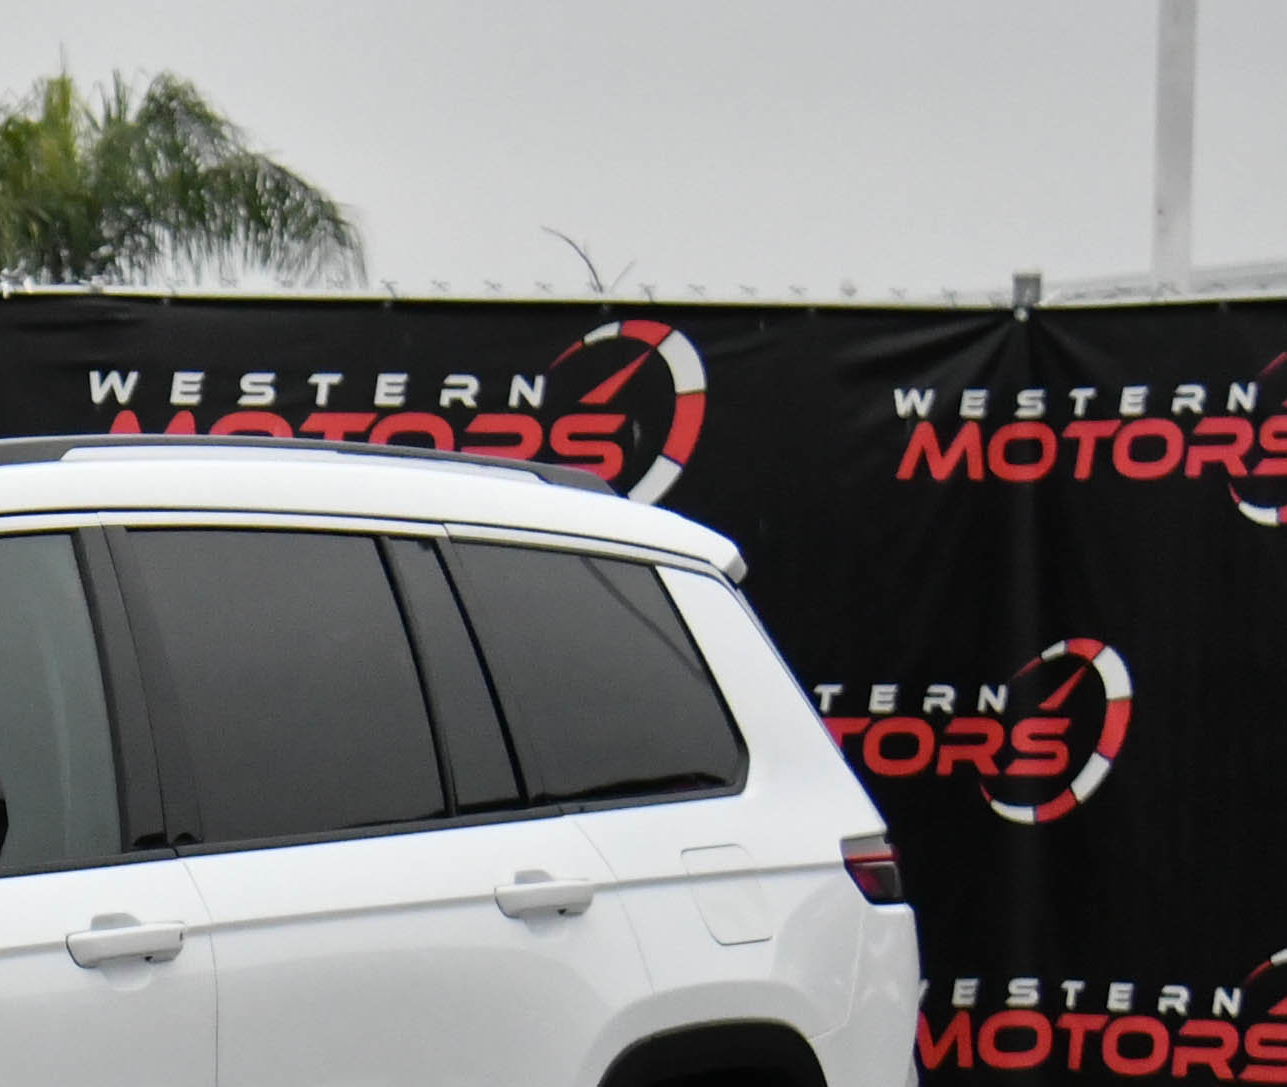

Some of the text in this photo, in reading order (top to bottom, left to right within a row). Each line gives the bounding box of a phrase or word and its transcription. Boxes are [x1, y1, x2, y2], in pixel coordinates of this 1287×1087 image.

[89, 371, 545, 407] WESTERN
[893, 383, 1258, 418] WESTERN
[921, 977, 1242, 1018] ESTERN
